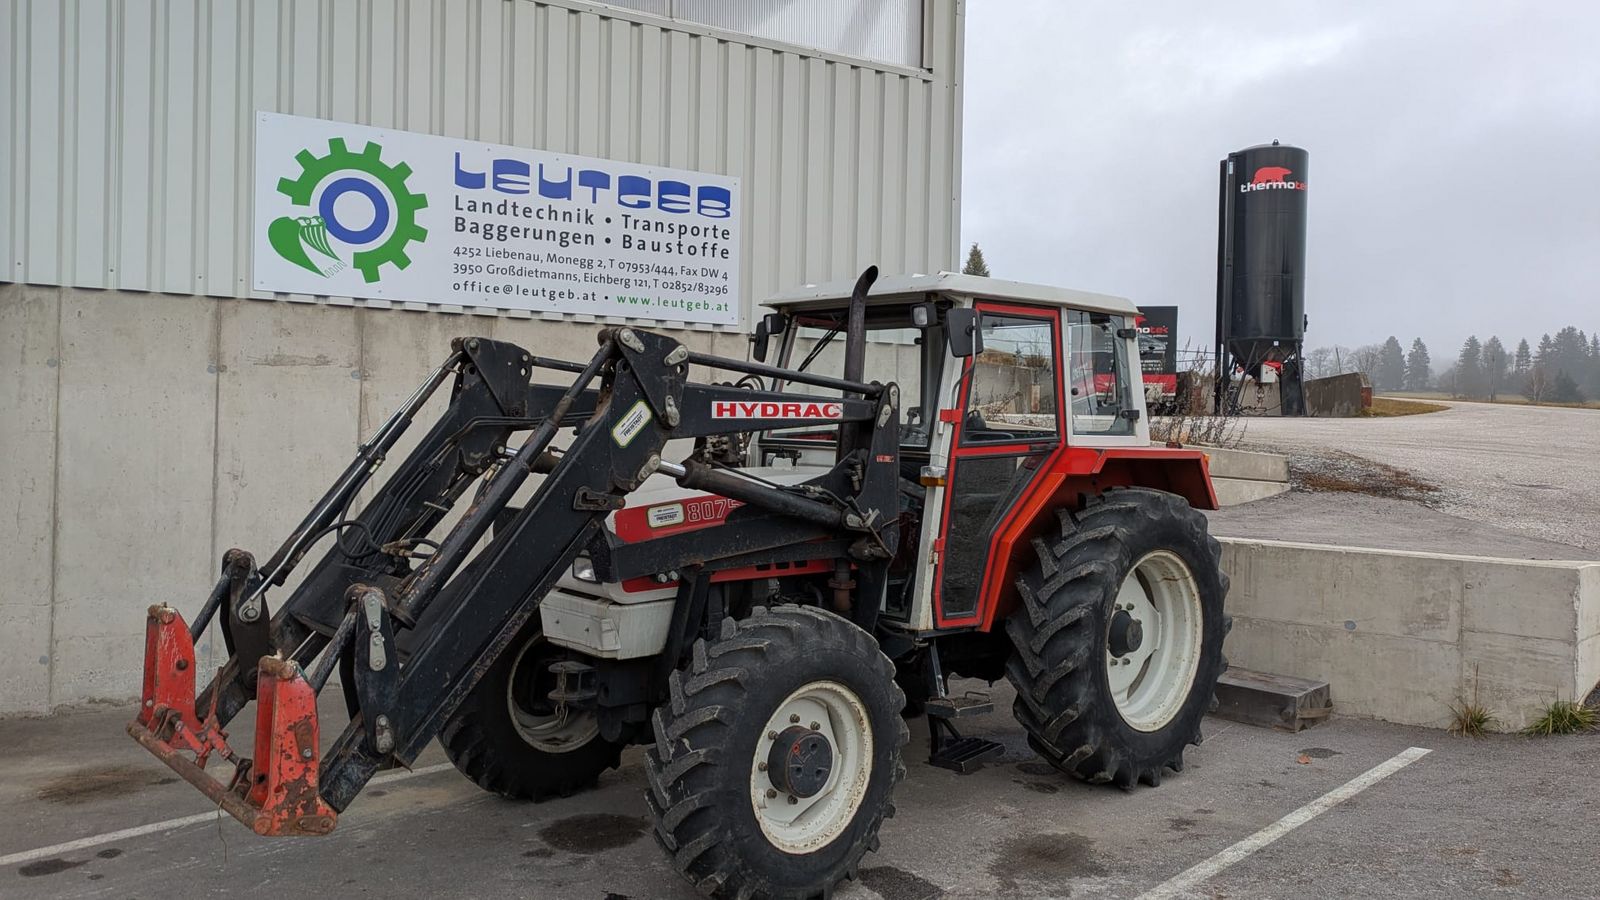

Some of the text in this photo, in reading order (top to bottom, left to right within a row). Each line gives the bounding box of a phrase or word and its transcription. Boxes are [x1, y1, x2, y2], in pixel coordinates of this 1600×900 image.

[454, 151, 731, 219] LEUTGEB
[1240, 181, 1309, 193] thermote
[454, 194, 731, 240] Landtechnik Transporte
[454, 216, 730, 260] Baggerungen Baustoffe
[452, 262, 729, 297] 3950 Großdietmanns, Eichberg 121, T 02852/83296
[453, 246, 729, 282] 4252 Liebenau, Monegg 2, T 07953/444, Fax DW 4
[452, 280, 729, 313] office@leutgeb.at www.leutgeb.at
[716, 402, 841, 418] HYDRAC
